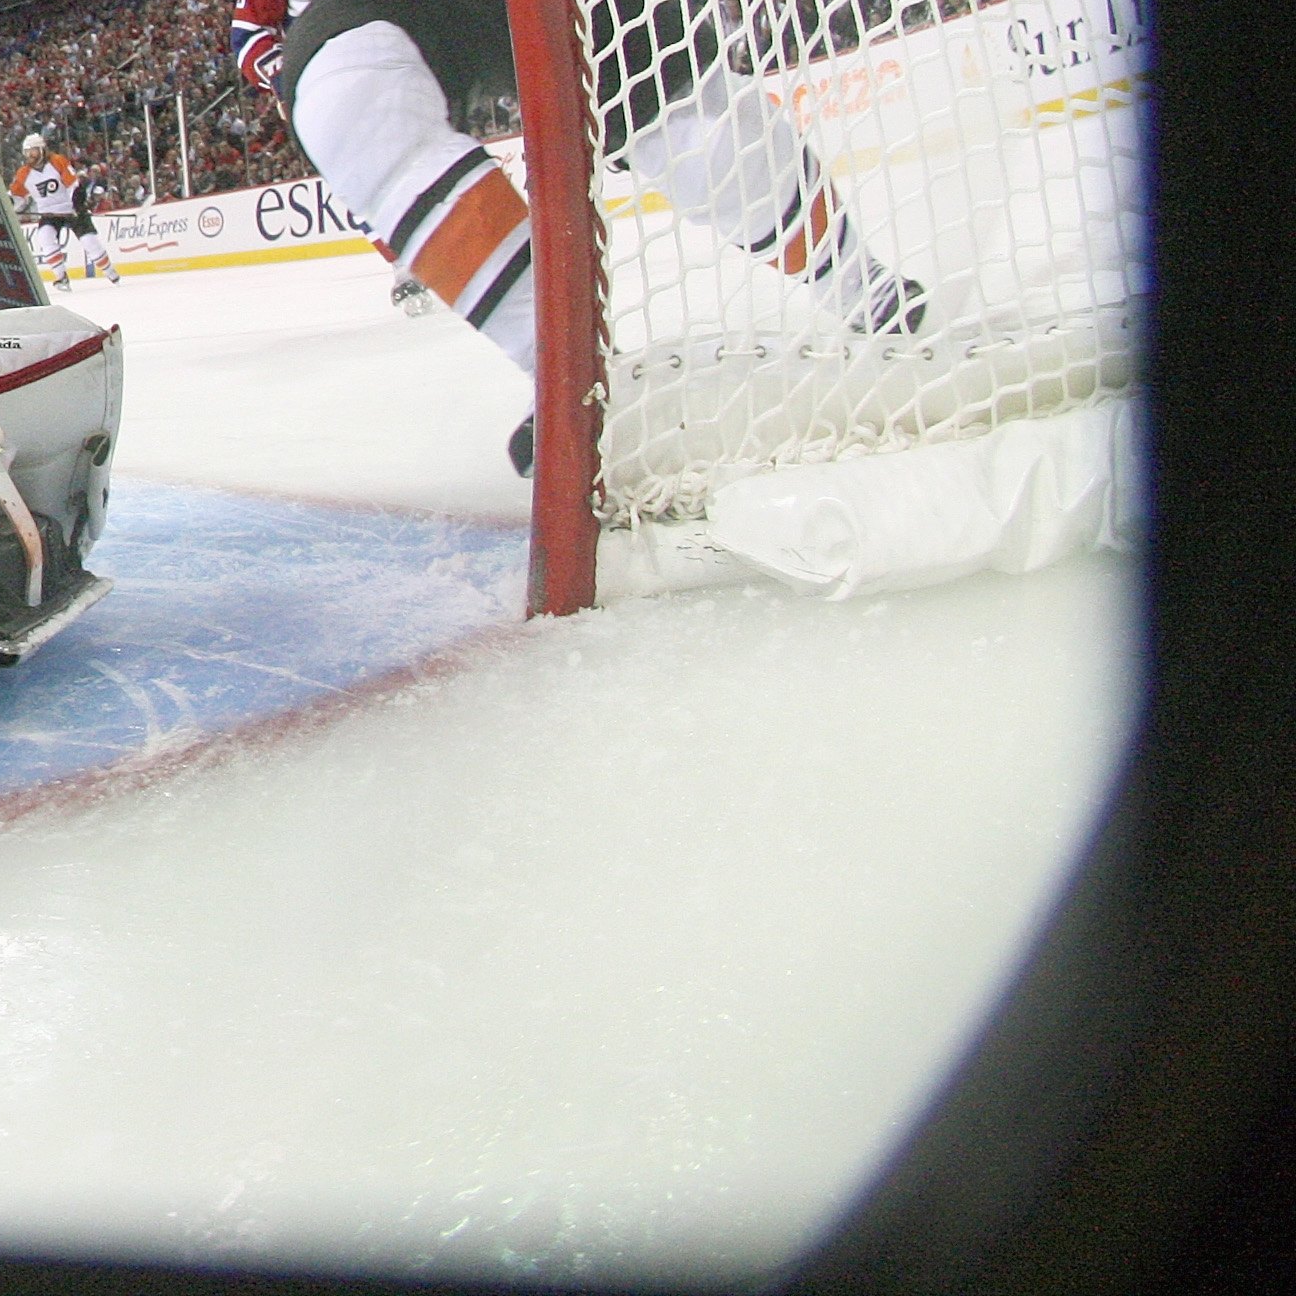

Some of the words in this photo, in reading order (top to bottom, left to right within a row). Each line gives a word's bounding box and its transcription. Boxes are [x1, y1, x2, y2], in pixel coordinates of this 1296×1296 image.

[108, 214, 147, 243] Marché
[147, 215, 189, 238] Express
[202, 216, 221, 229] Esso
